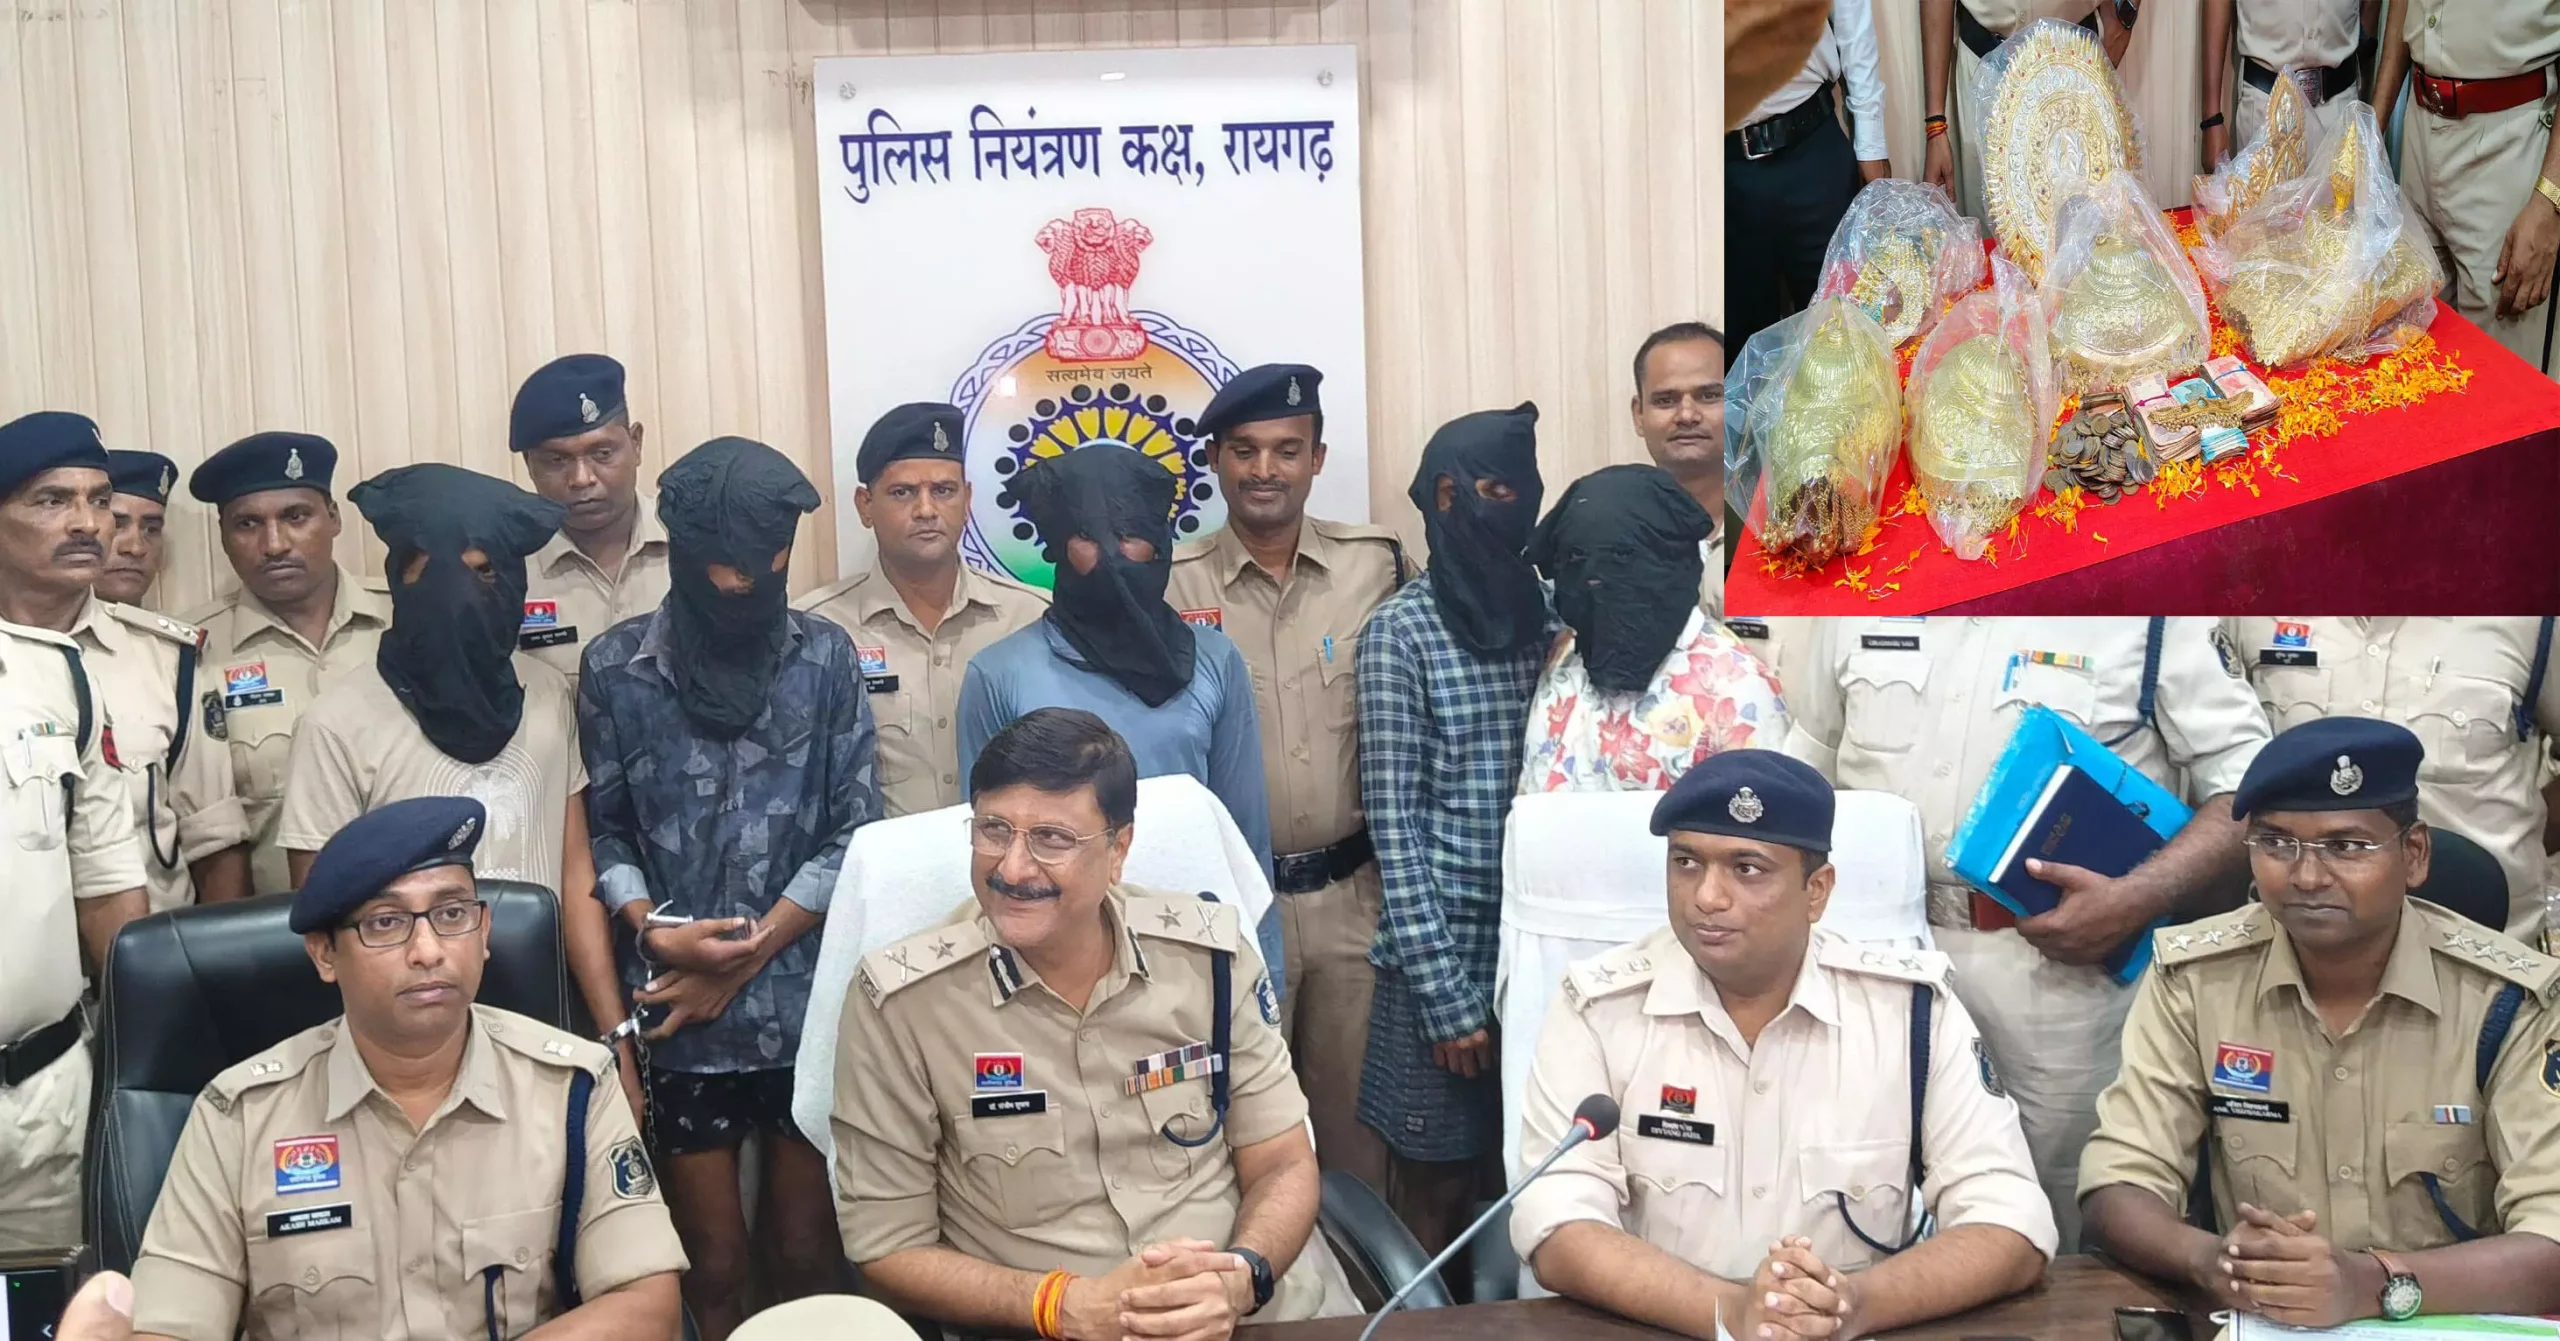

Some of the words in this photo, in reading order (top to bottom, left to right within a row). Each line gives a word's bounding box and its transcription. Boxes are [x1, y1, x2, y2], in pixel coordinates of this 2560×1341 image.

[839, 107, 952, 204] पुलिस
[969, 103, 1102, 180] नियंत्रण
[1119, 123, 1205, 186] कक्ष,
[1221, 120, 1335, 183] रायगढ़
[1045, 364, 1106, 382] सत्यमेव
[1110, 361, 1153, 380] जयते
